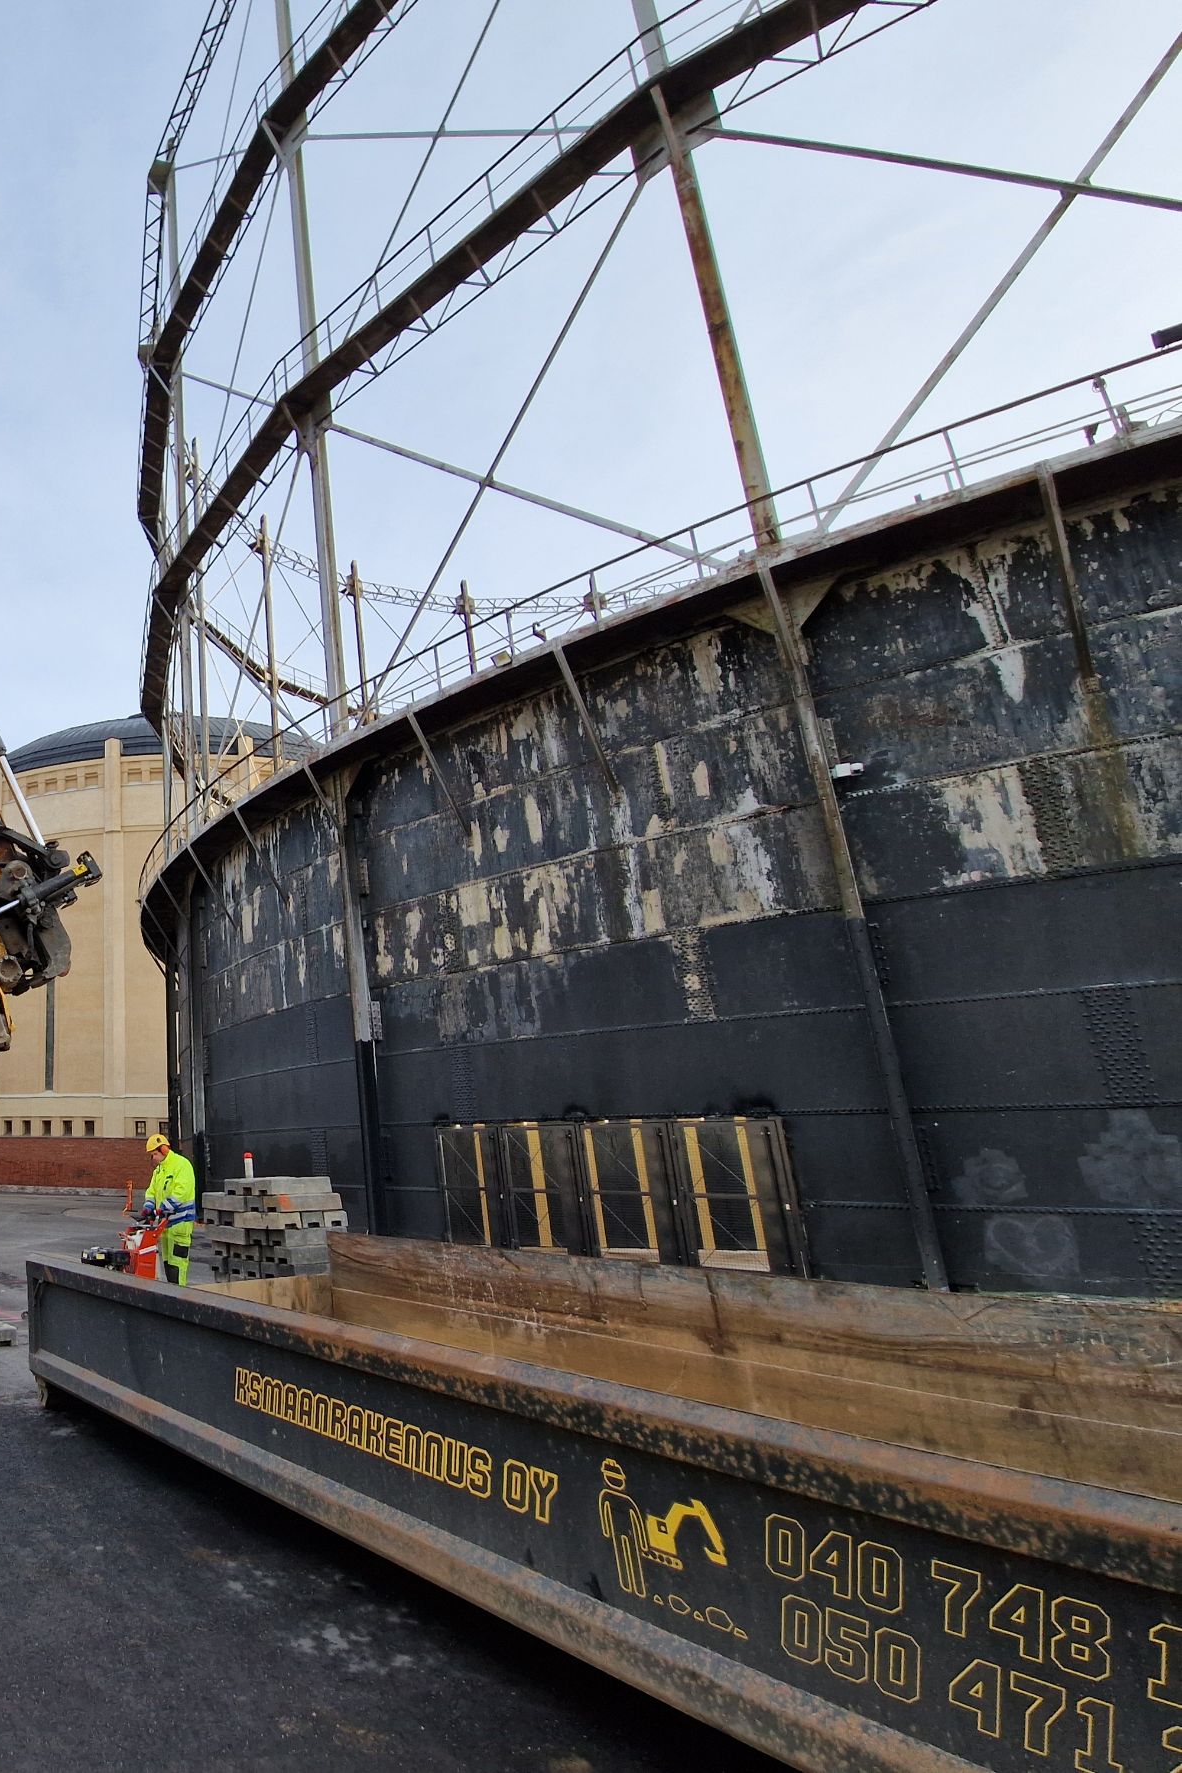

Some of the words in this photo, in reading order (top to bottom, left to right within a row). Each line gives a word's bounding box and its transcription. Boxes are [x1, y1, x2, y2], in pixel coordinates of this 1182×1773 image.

[502, 1458, 559, 1524] OY
[766, 1513, 903, 1614] 040
[931, 1559, 1112, 1682] 748
[781, 1594, 921, 1704] 050
[948, 1659, 1124, 1773] 471
